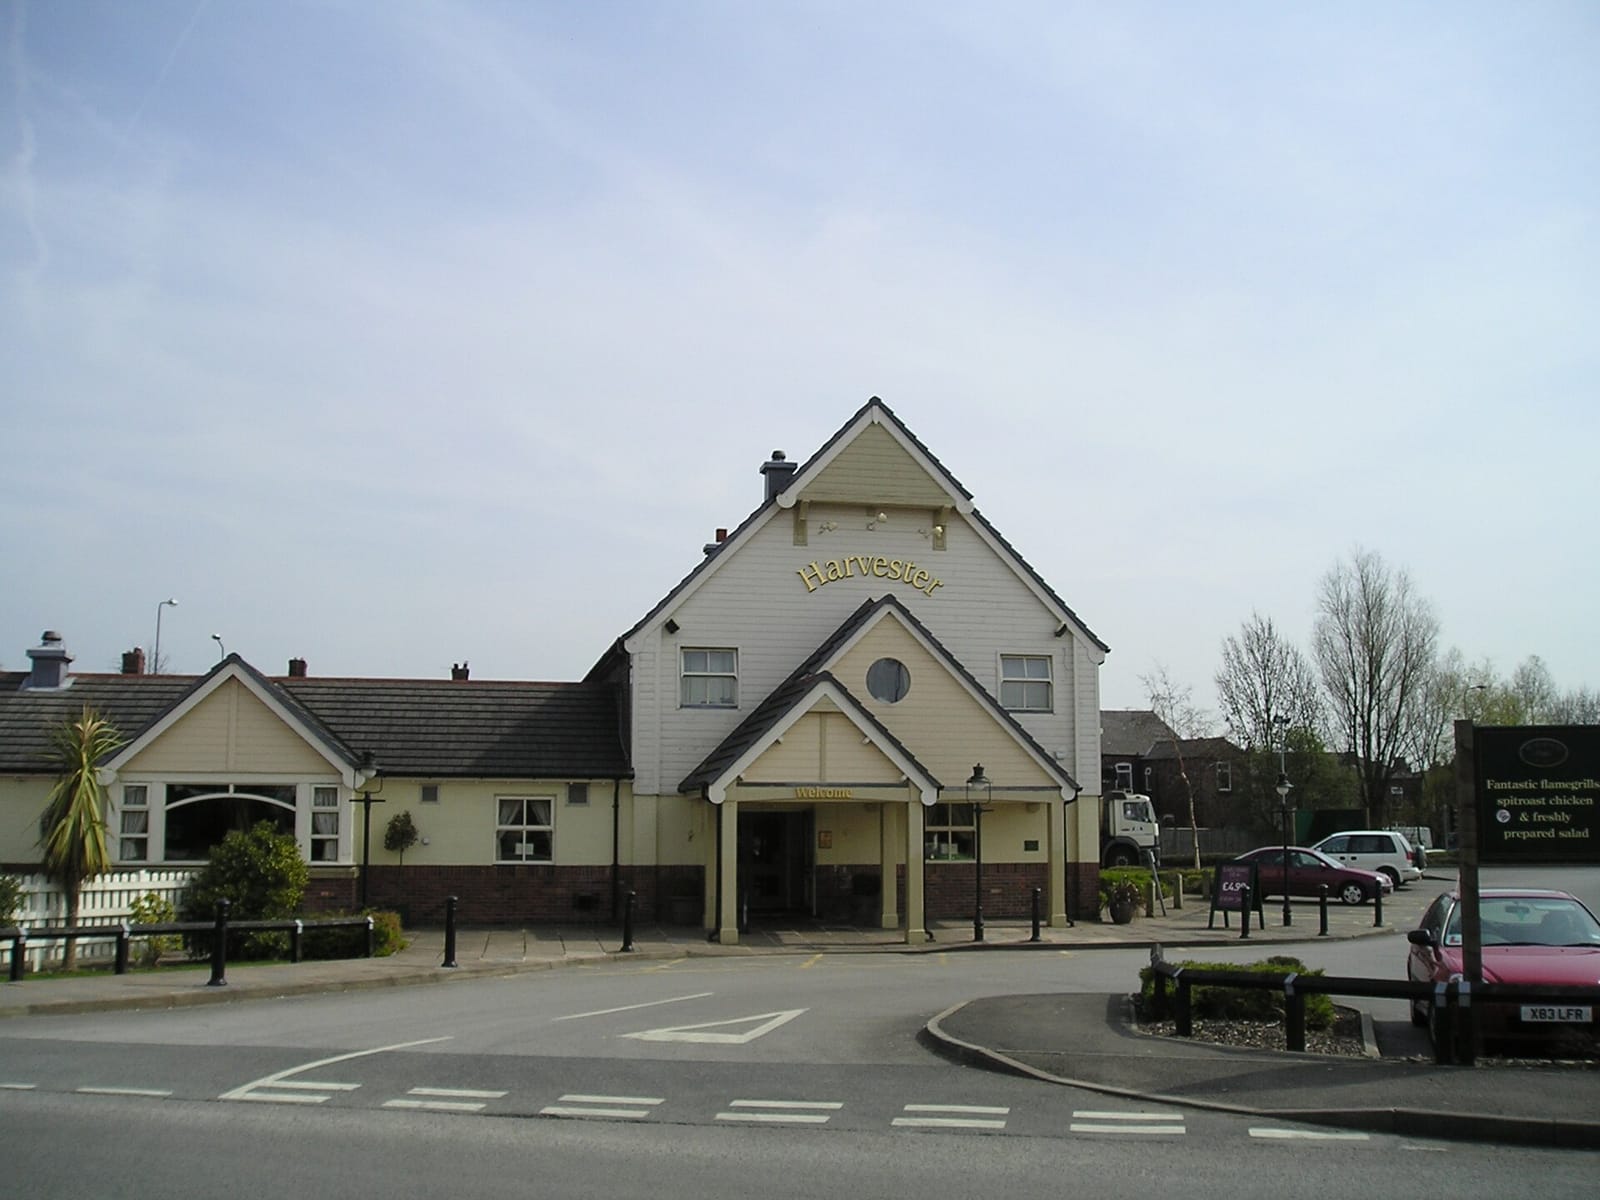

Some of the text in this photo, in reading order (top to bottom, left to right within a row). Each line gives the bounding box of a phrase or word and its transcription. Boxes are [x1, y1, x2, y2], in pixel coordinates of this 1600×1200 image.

[796, 554, 944, 597] Harvester
[1486, 779, 1538, 790] Fantastic
[795, 786, 853, 800] Welcome
[1497, 795, 1593, 808] spitroast chicken
[1519, 811, 1571, 823] & freshly
[1503, 828, 1589, 841] prepared salad
[1558, 1008, 1583, 1020] LFR
